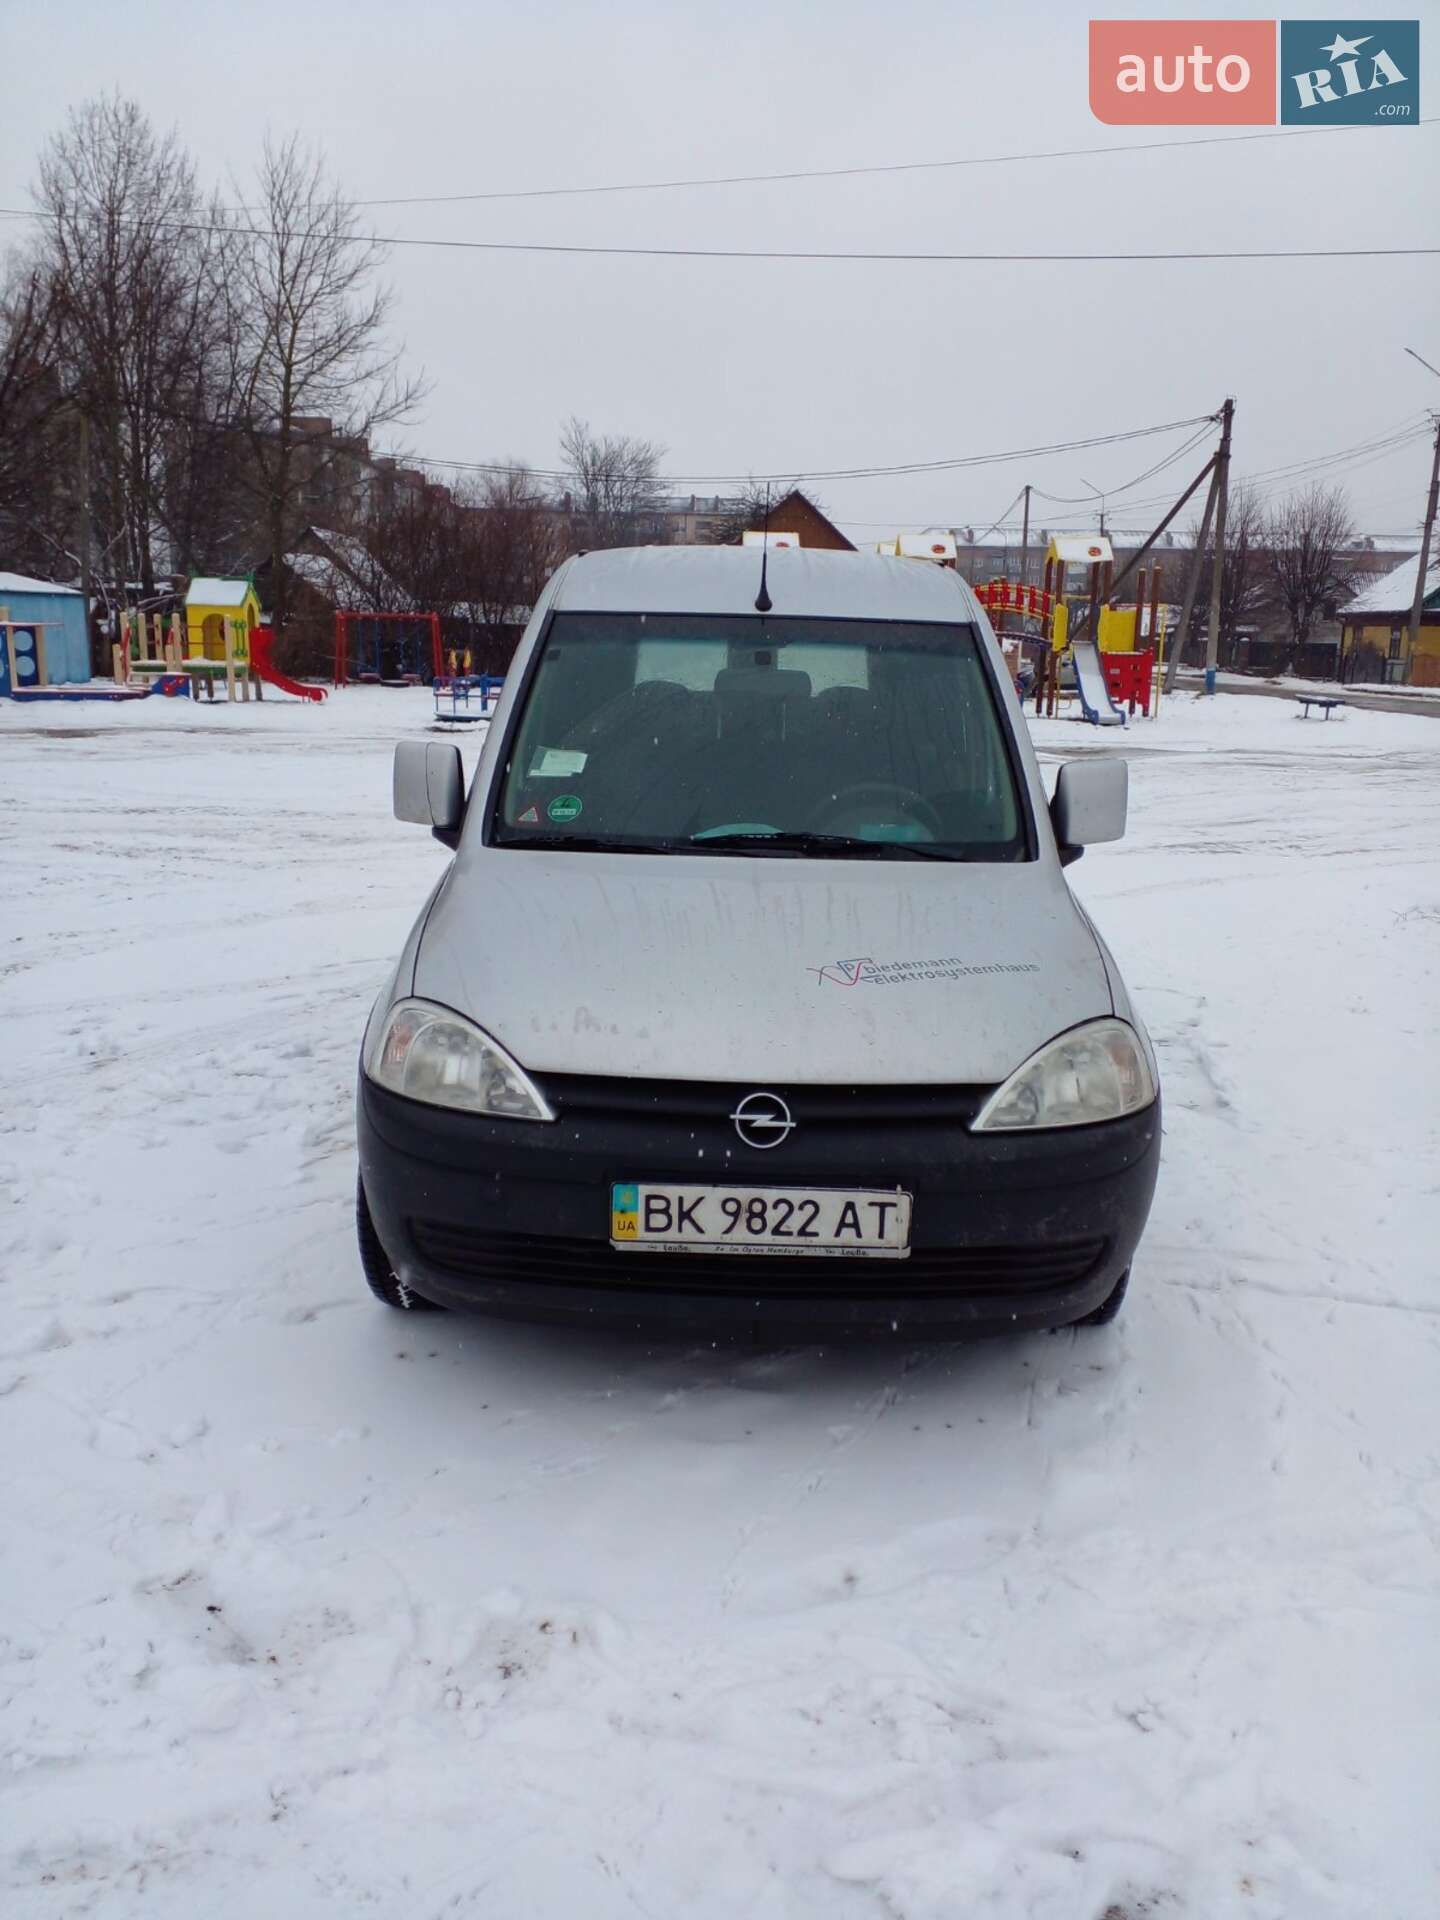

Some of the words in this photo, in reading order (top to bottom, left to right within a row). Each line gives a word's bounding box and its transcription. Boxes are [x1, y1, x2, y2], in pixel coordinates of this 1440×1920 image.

[874, 963, 1041, 985] elektrosystemhaus
[617, 1220, 636, 1231] UA
[644, 1194, 705, 1234] BK
[720, 1197, 820, 1237] 9822
[834, 1201, 898, 1240] AT
